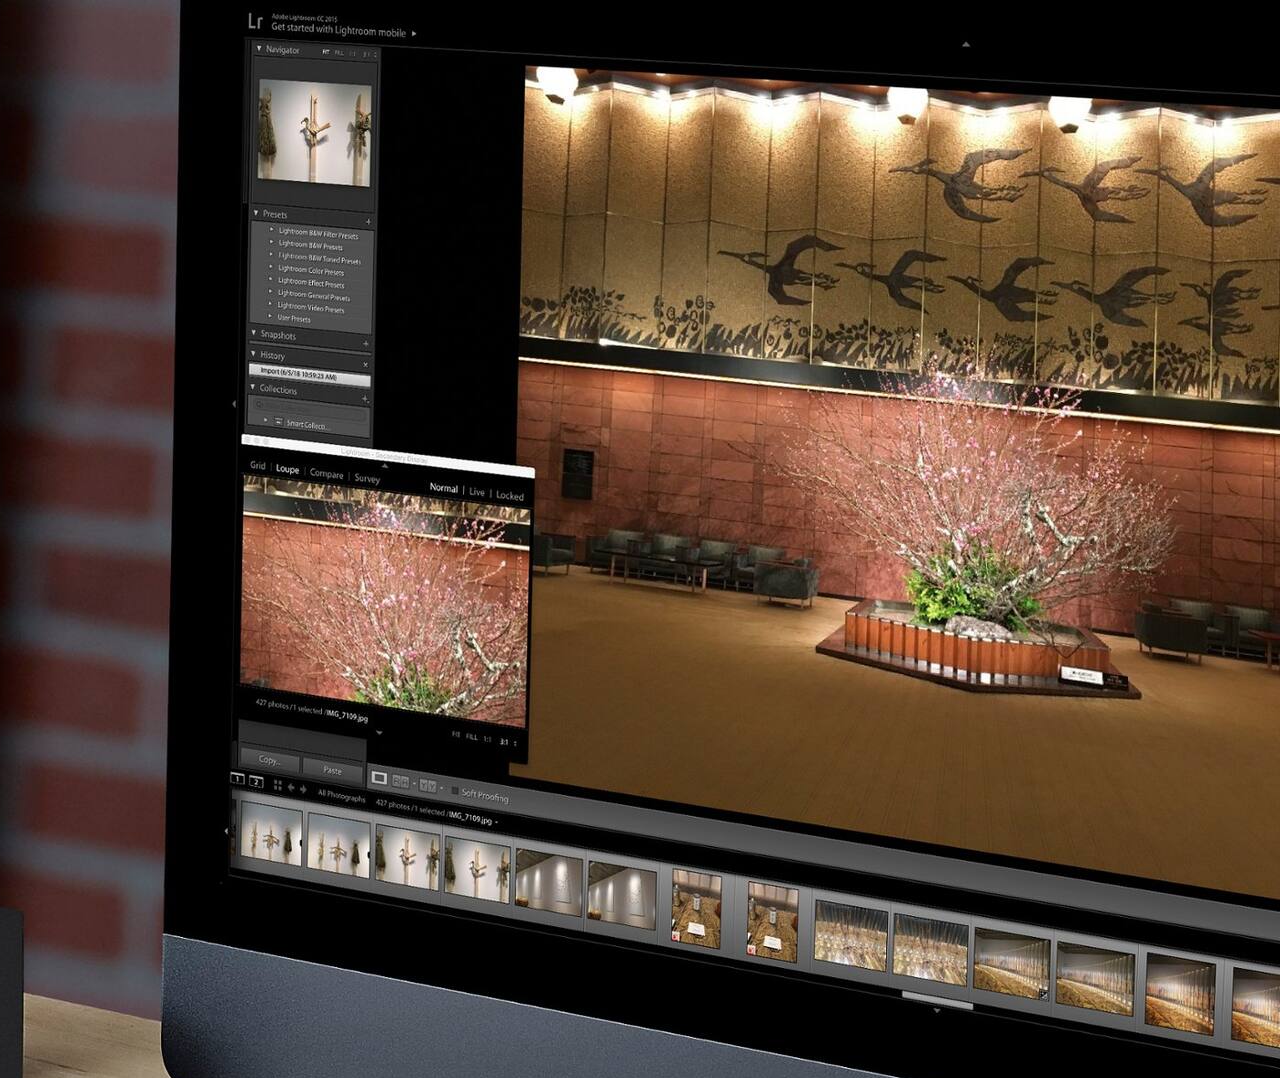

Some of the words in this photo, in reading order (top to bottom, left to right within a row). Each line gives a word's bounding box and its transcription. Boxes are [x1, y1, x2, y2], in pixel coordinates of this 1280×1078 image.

[248, 12, 263, 30] Lr
[271, 22, 286, 31] Get
[286, 23, 315, 33] started
[315, 24, 333, 34] with
[335, 25, 377, 37] Lightroom
[378, 28, 407, 38] mobile
[265, 44, 300, 56] Navigator
[263, 209, 288, 219] Presets
[279, 227, 308, 236] Lightroom
[338, 232, 359, 240] Presets
[279, 239, 308, 248] Lightroom
[323, 243, 343, 251] Presets
[278, 251, 307, 261] Lightroom
[341, 257, 361, 265] Presets
[278, 264, 307, 273] Lightroom
[308, 267, 323, 275] Color
[325, 268, 344, 277] Presets
[278, 277, 307, 285] Lightroom
[308, 279, 323, 288] Effect
[325, 281, 344, 289] Presets
[278, 289, 307, 298] Lightroom
[330, 294, 350, 302] Presets
[278, 301, 307, 310] Lightroom
[307, 304, 323, 312] Video
[324, 306, 344, 314] Presets
[291, 315, 311, 323] Presets
[261, 330, 296, 341] Snapshots
[260, 351, 286, 361] History
[261, 367, 280, 376] Import
[260, 384, 297, 396] Collections
[287, 419, 303, 428] Smart
[250, 461, 266, 471] Grid
[276, 464, 300, 475] Loupe
[310, 468, 344, 480] Compare
[355, 473, 381, 486] Survey
[430, 482, 458, 494] Normal
[469, 487, 485, 497] Live
[496, 491, 525, 502] Locked
[268, 701, 289, 711] photos
[298, 706, 323, 715] selected
[323, 765, 342, 776] Paste
[318, 789, 326, 797] All
[327, 790, 366, 804] Photographs
[462, 788, 477, 798] Soft
[478, 791, 509, 805] Proofing
[376, 799, 387, 807] 427
[389, 801, 410, 811] photos
[419, 807, 445, 817] selected
